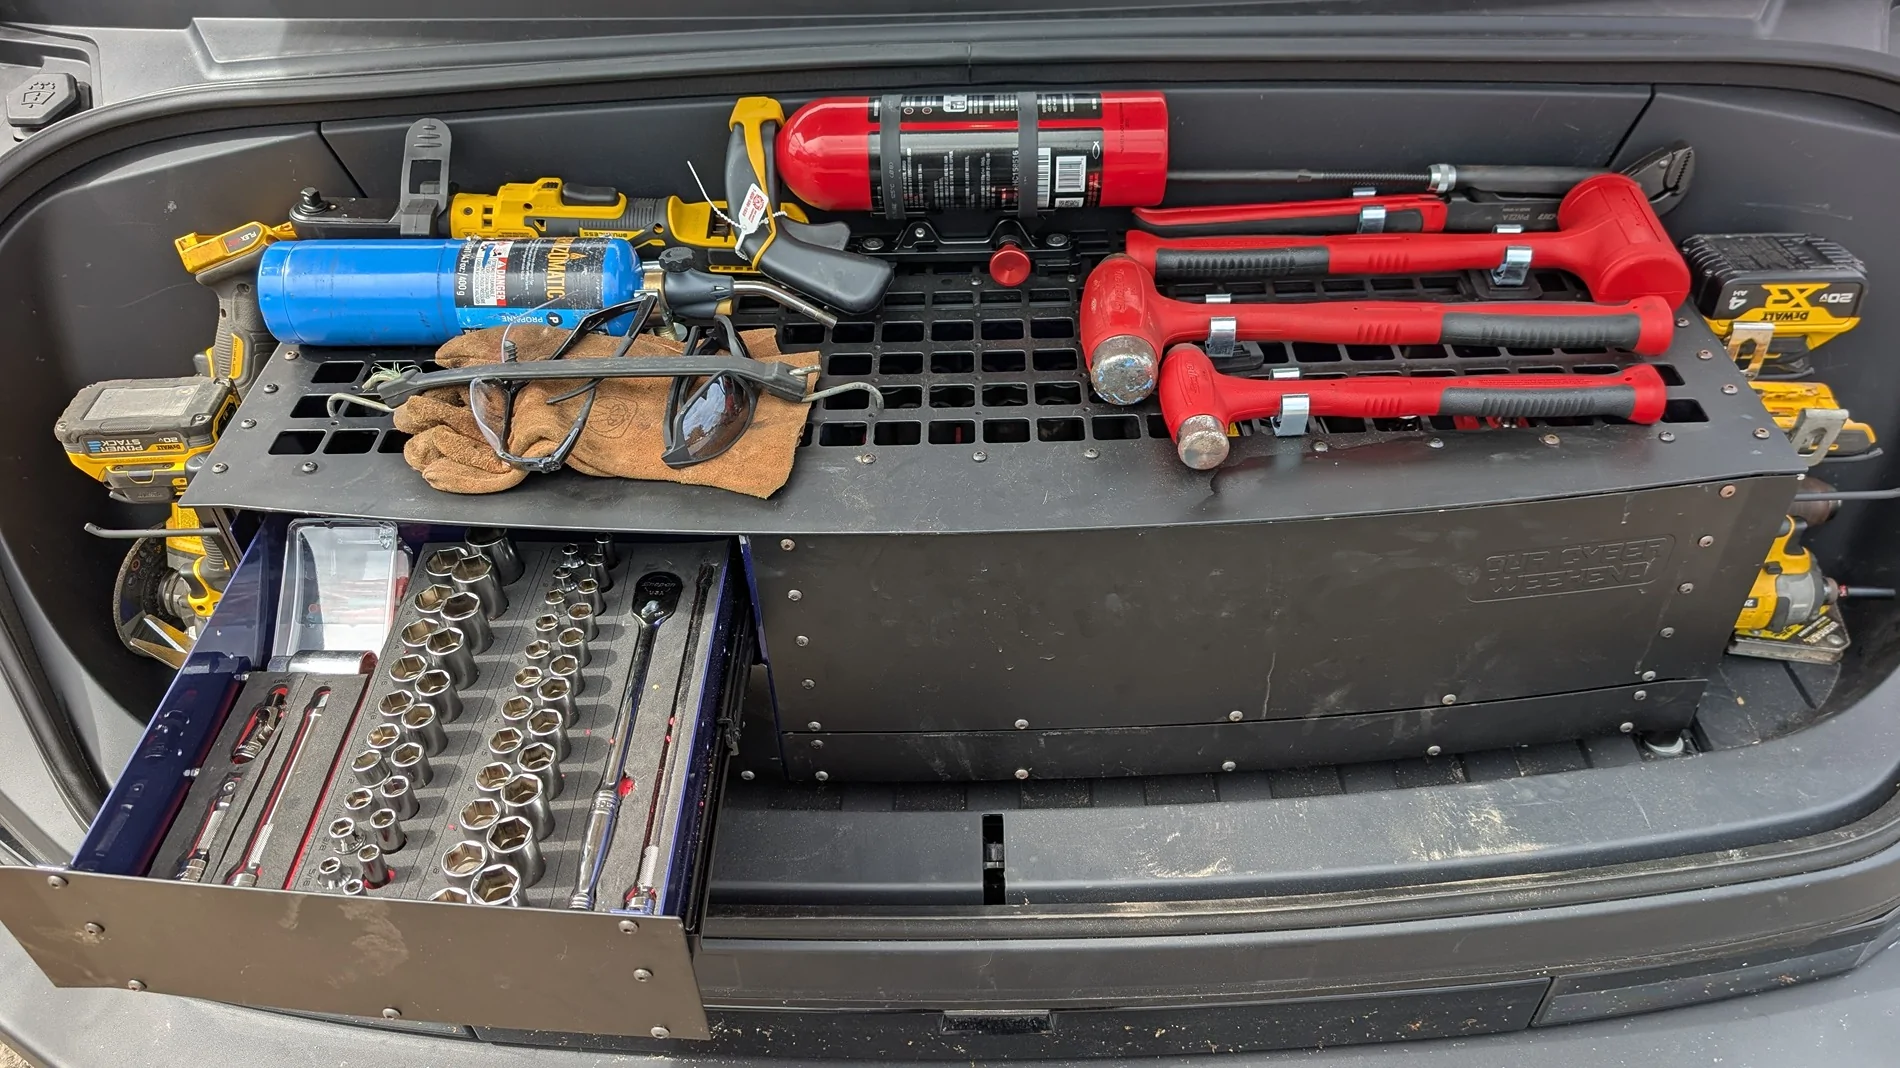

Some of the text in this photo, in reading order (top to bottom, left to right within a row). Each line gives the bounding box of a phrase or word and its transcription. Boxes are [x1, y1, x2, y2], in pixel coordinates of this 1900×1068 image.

[496, 269, 506, 300] DANGER
[1760, 283, 1830, 308] XR
[1729, 296, 1747, 310] 4
[502, 315, 543, 323] PROPANE
[100, 444, 143, 453] POWER
